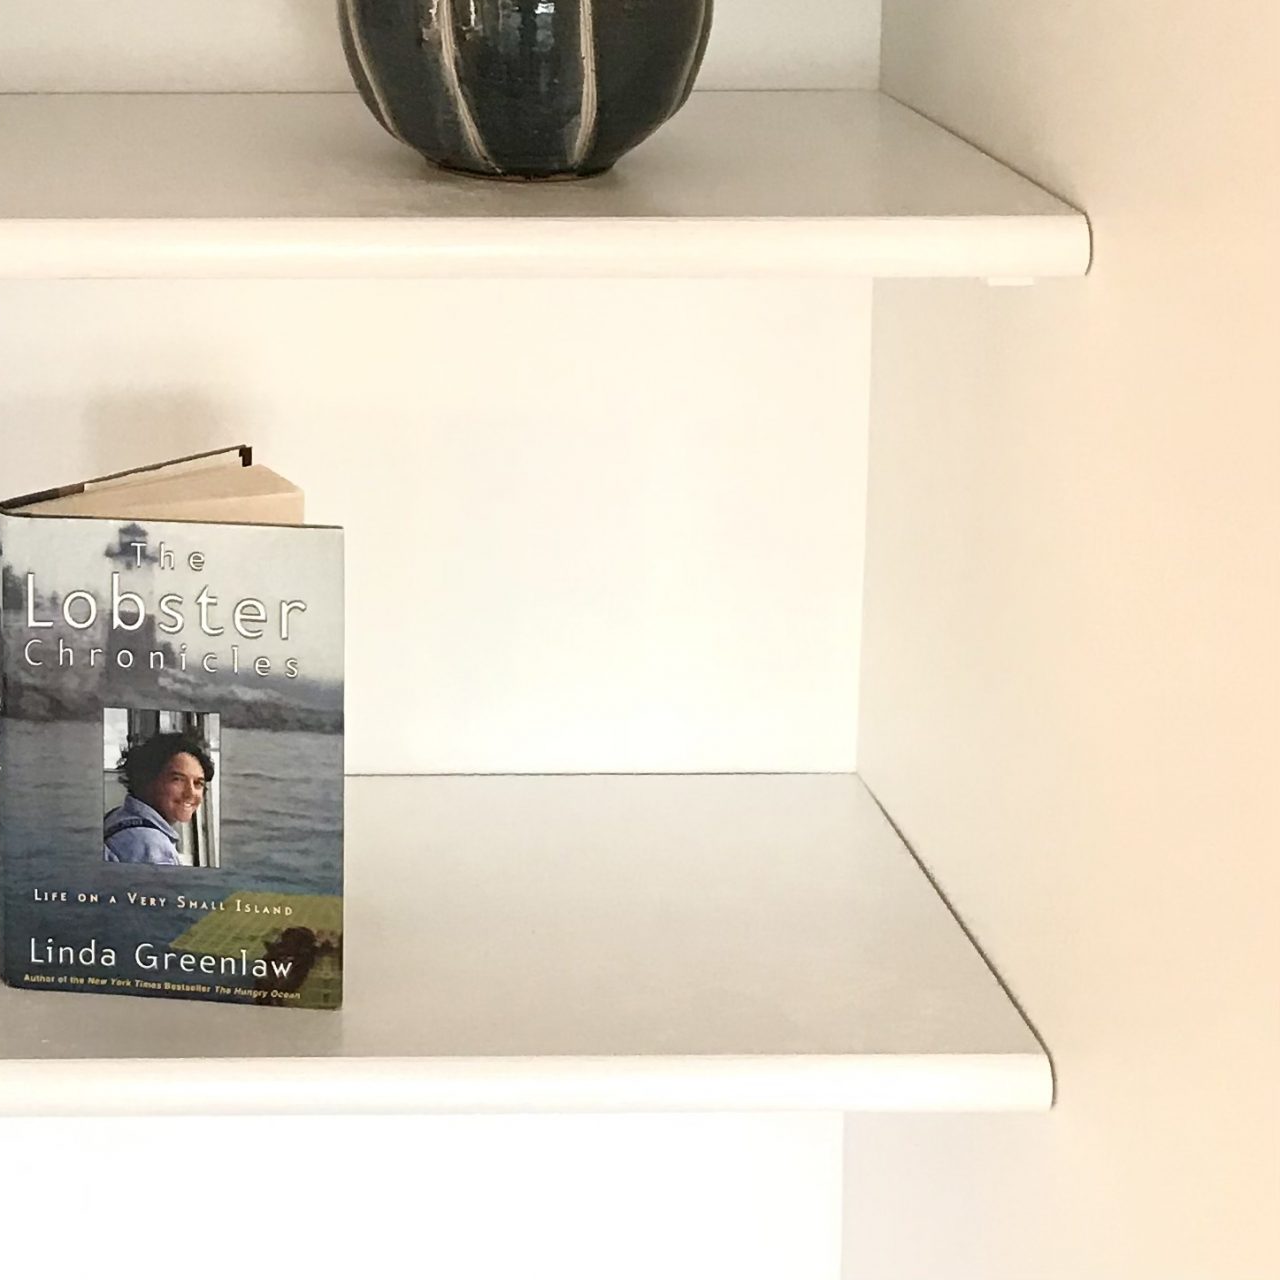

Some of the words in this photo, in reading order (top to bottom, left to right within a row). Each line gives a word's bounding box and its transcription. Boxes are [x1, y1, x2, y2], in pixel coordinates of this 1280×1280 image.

[130, 541, 207, 571] The
[25, 572, 308, 640] Lobster
[23, 638, 300, 679] Chronicles
[29, 937, 117, 968] Linda
[134, 942, 294, 980] Greenlaw
[24, 974, 56, 984] Author
[58, 975, 68, 984] of
[70, 976, 85, 985] the
[87, 977, 108, 986] New
[111, 978, 131, 988] York
[134, 980, 162, 990] Times
[164, 981, 211, 993] Bestseller
[214, 985, 232, 995] The
[234, 986, 268, 999] Hungry
[270, 989, 302, 1000] Ocean
